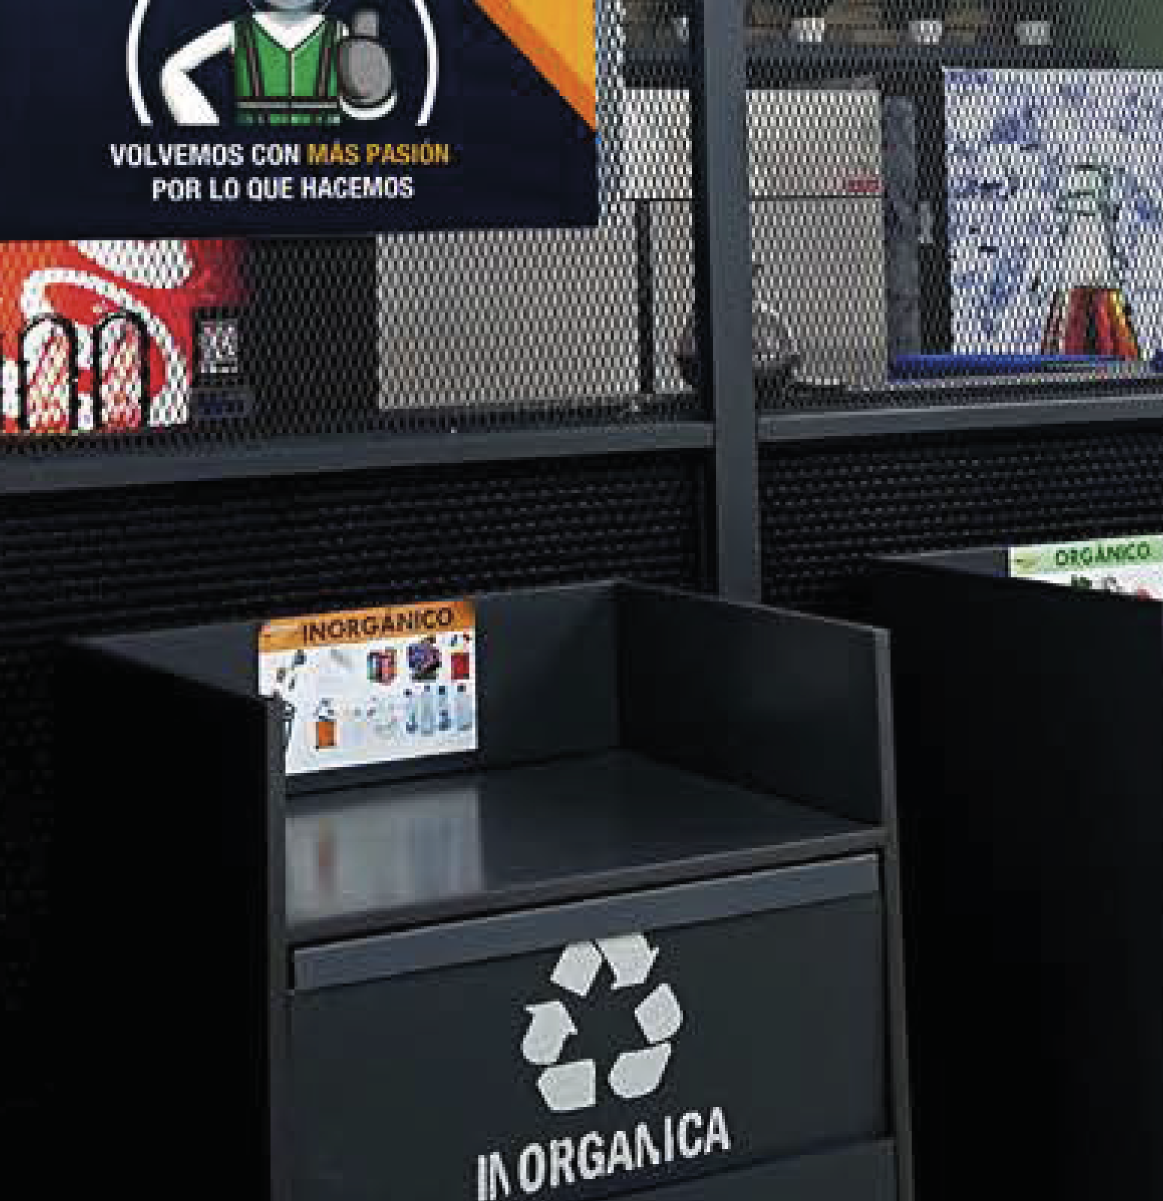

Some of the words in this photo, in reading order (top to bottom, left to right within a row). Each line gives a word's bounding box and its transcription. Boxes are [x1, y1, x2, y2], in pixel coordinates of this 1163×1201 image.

[109, 143, 245, 167] VOLVEMOS
[252, 143, 301, 166] CON
[306, 137, 361, 166] MÁS
[366, 137, 449, 166] PASIÓN
[151, 176, 203, 201] POR
[209, 176, 240, 201] LO
[246, 176, 295, 201] QUE
[301, 176, 416, 200] HACEMOS
